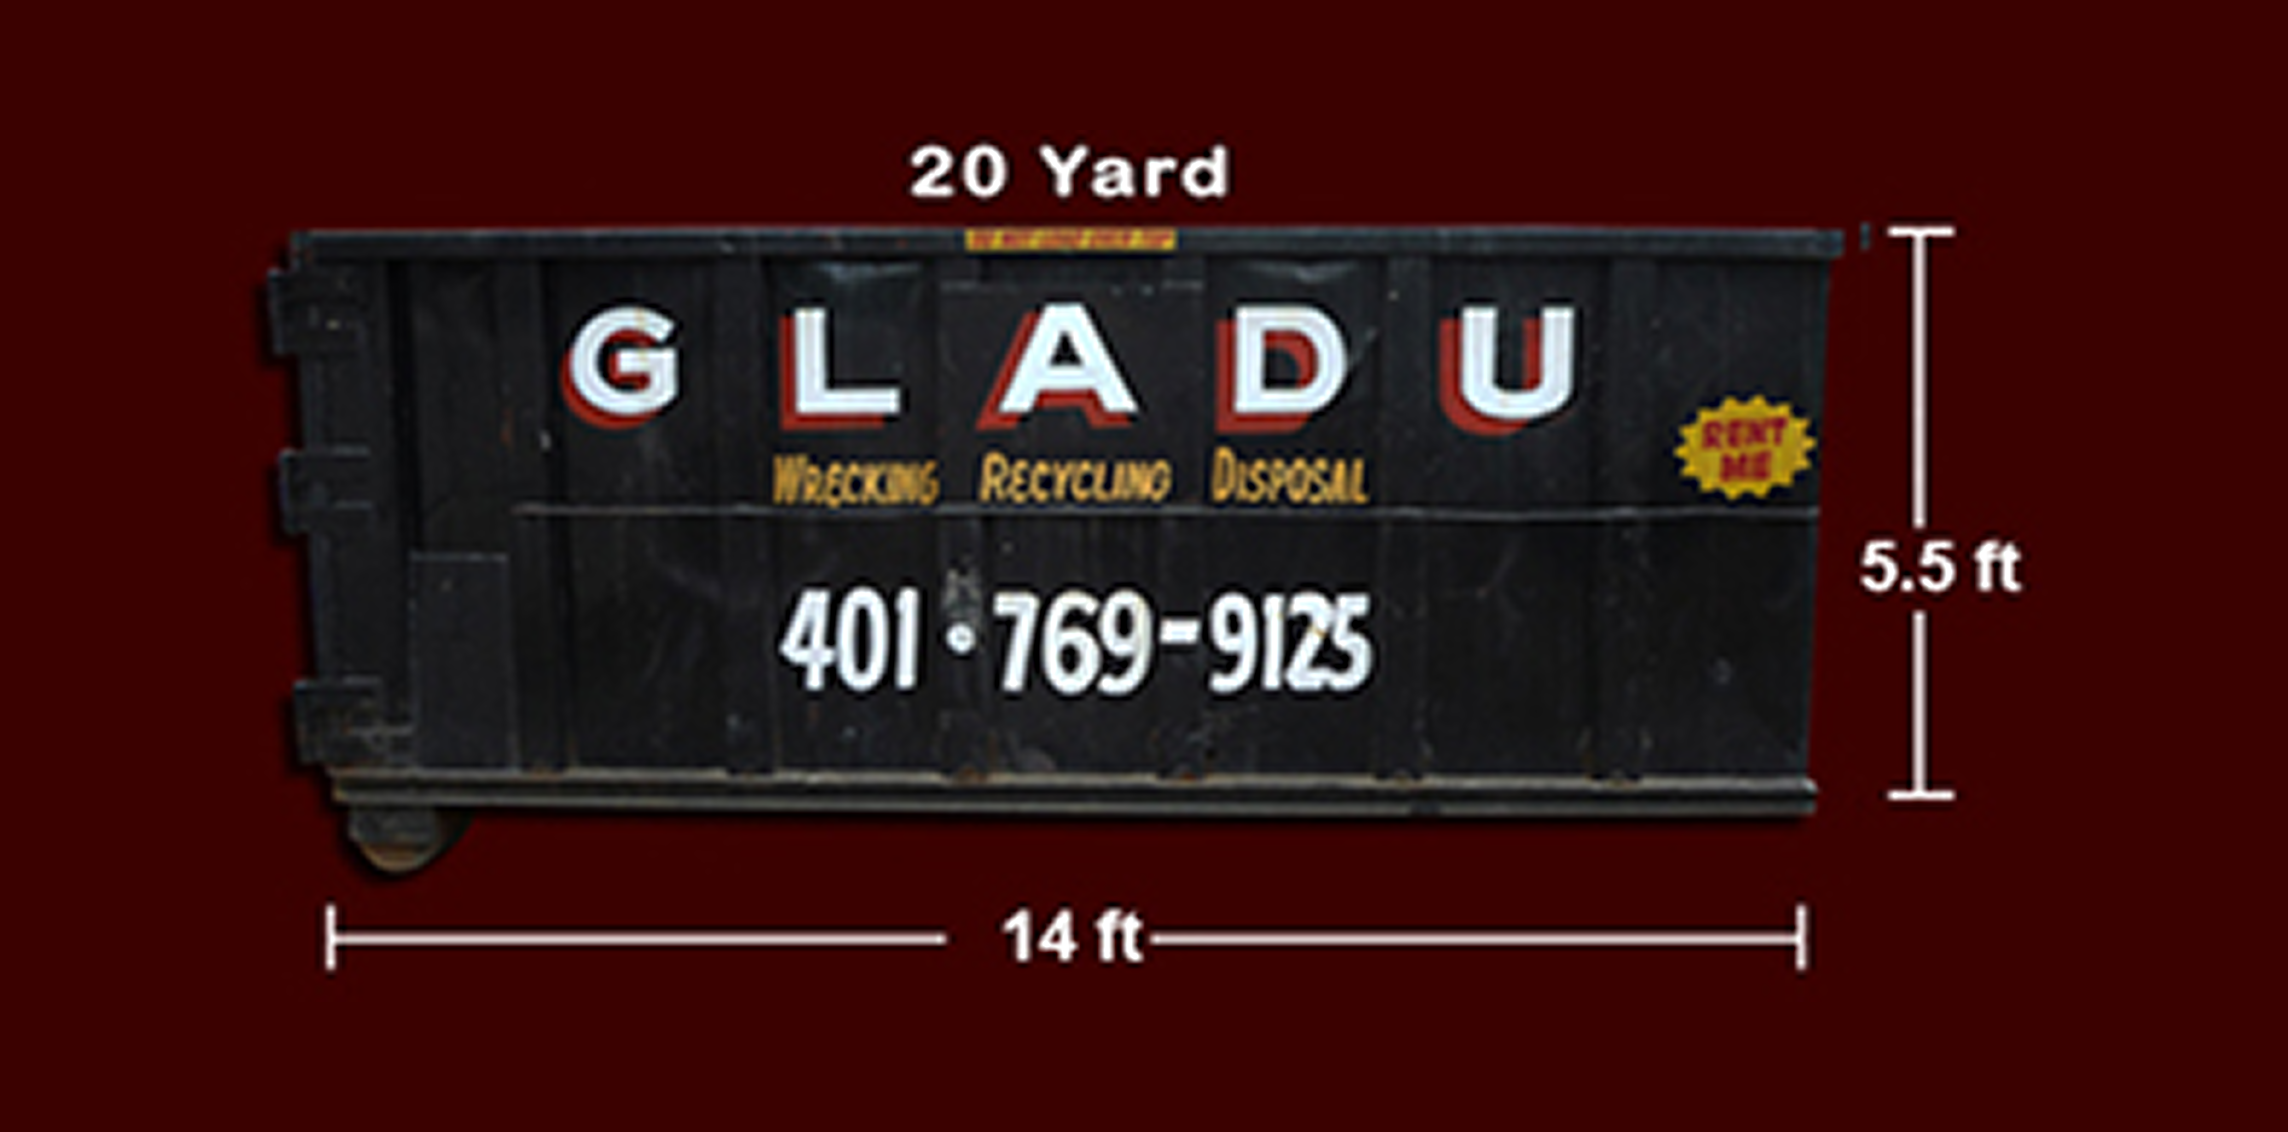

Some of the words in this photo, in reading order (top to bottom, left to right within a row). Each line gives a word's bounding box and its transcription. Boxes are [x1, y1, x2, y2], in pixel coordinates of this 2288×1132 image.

[1701, 416, 1788, 449] RENT
[773, 452, 941, 506] WRECKING
[979, 450, 1172, 503] RECYCLING
[1212, 445, 1370, 504] DISPOSAL
[1719, 449, 1772, 483] ME
